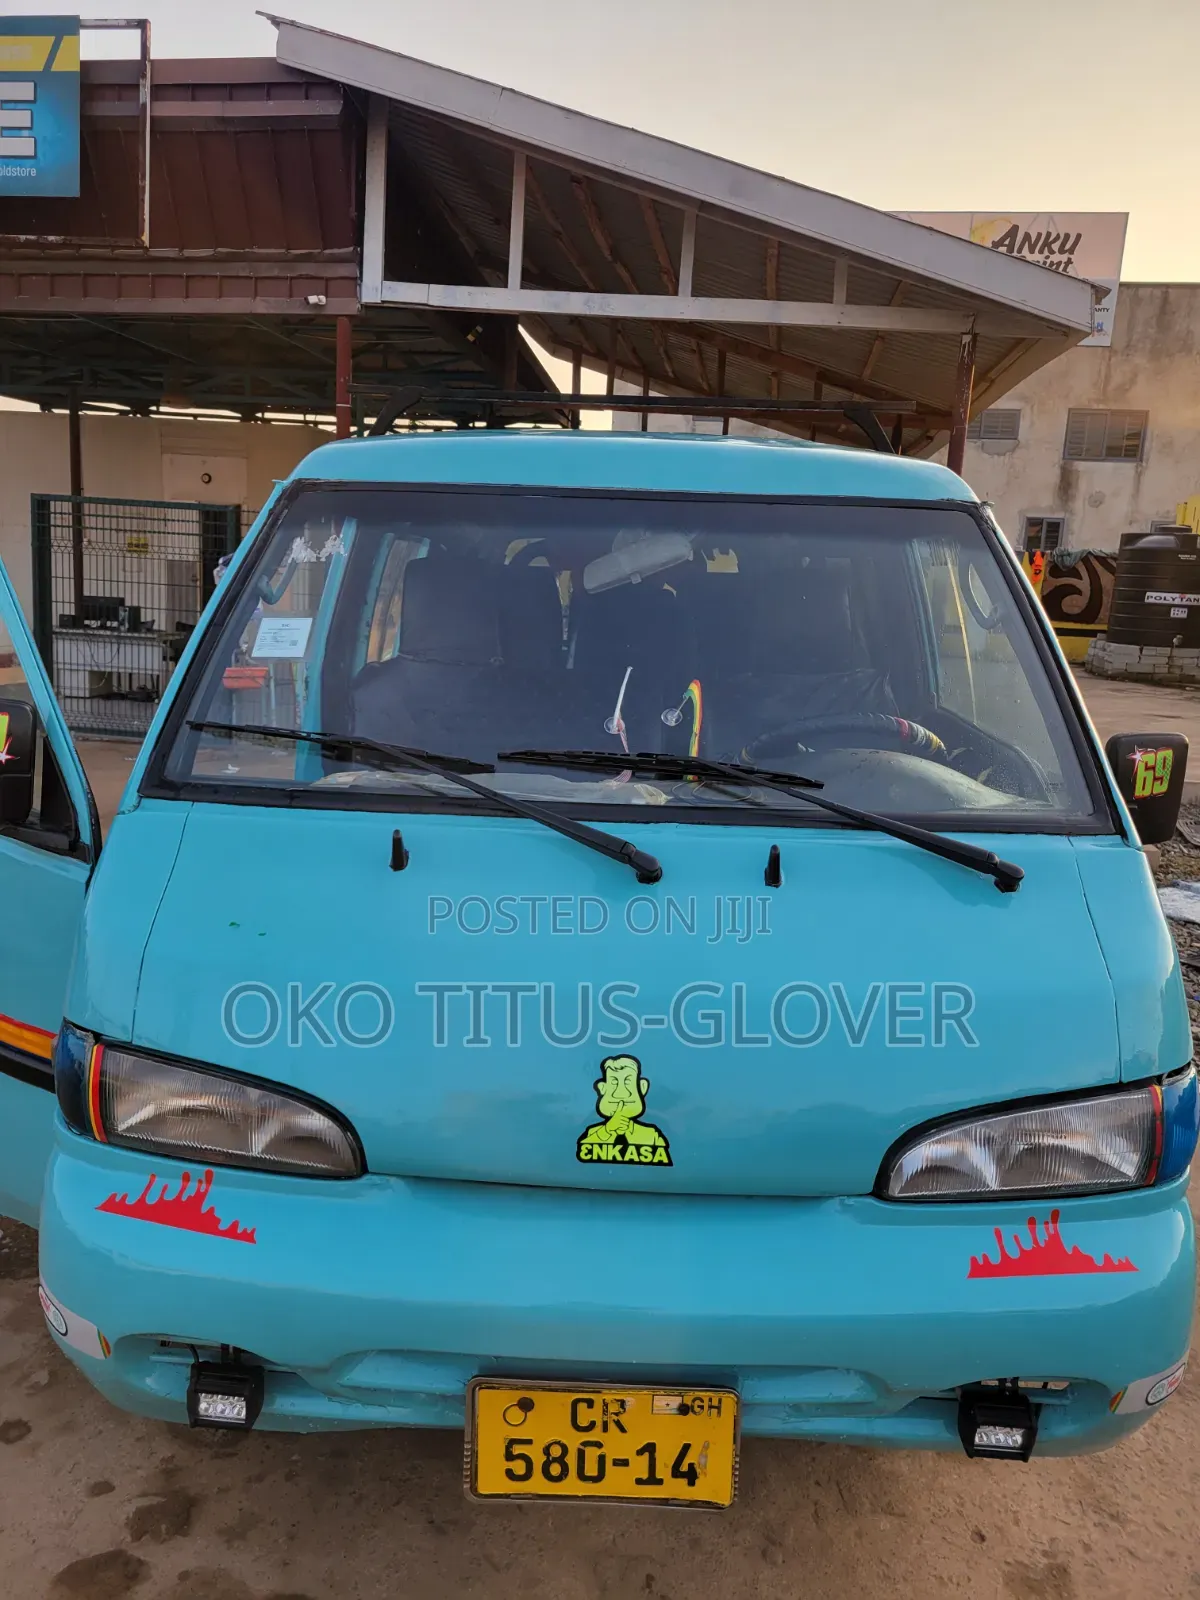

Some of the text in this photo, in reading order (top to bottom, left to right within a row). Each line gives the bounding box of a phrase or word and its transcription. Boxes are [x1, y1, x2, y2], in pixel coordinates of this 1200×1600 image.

[991, 224, 1082, 255] ANKU
[1134, 748, 1173, 799] 69
[570, 1397, 628, 1434] CR
[690, 1396, 723, 1418] GH
[504, 1437, 699, 1487] 580-14
